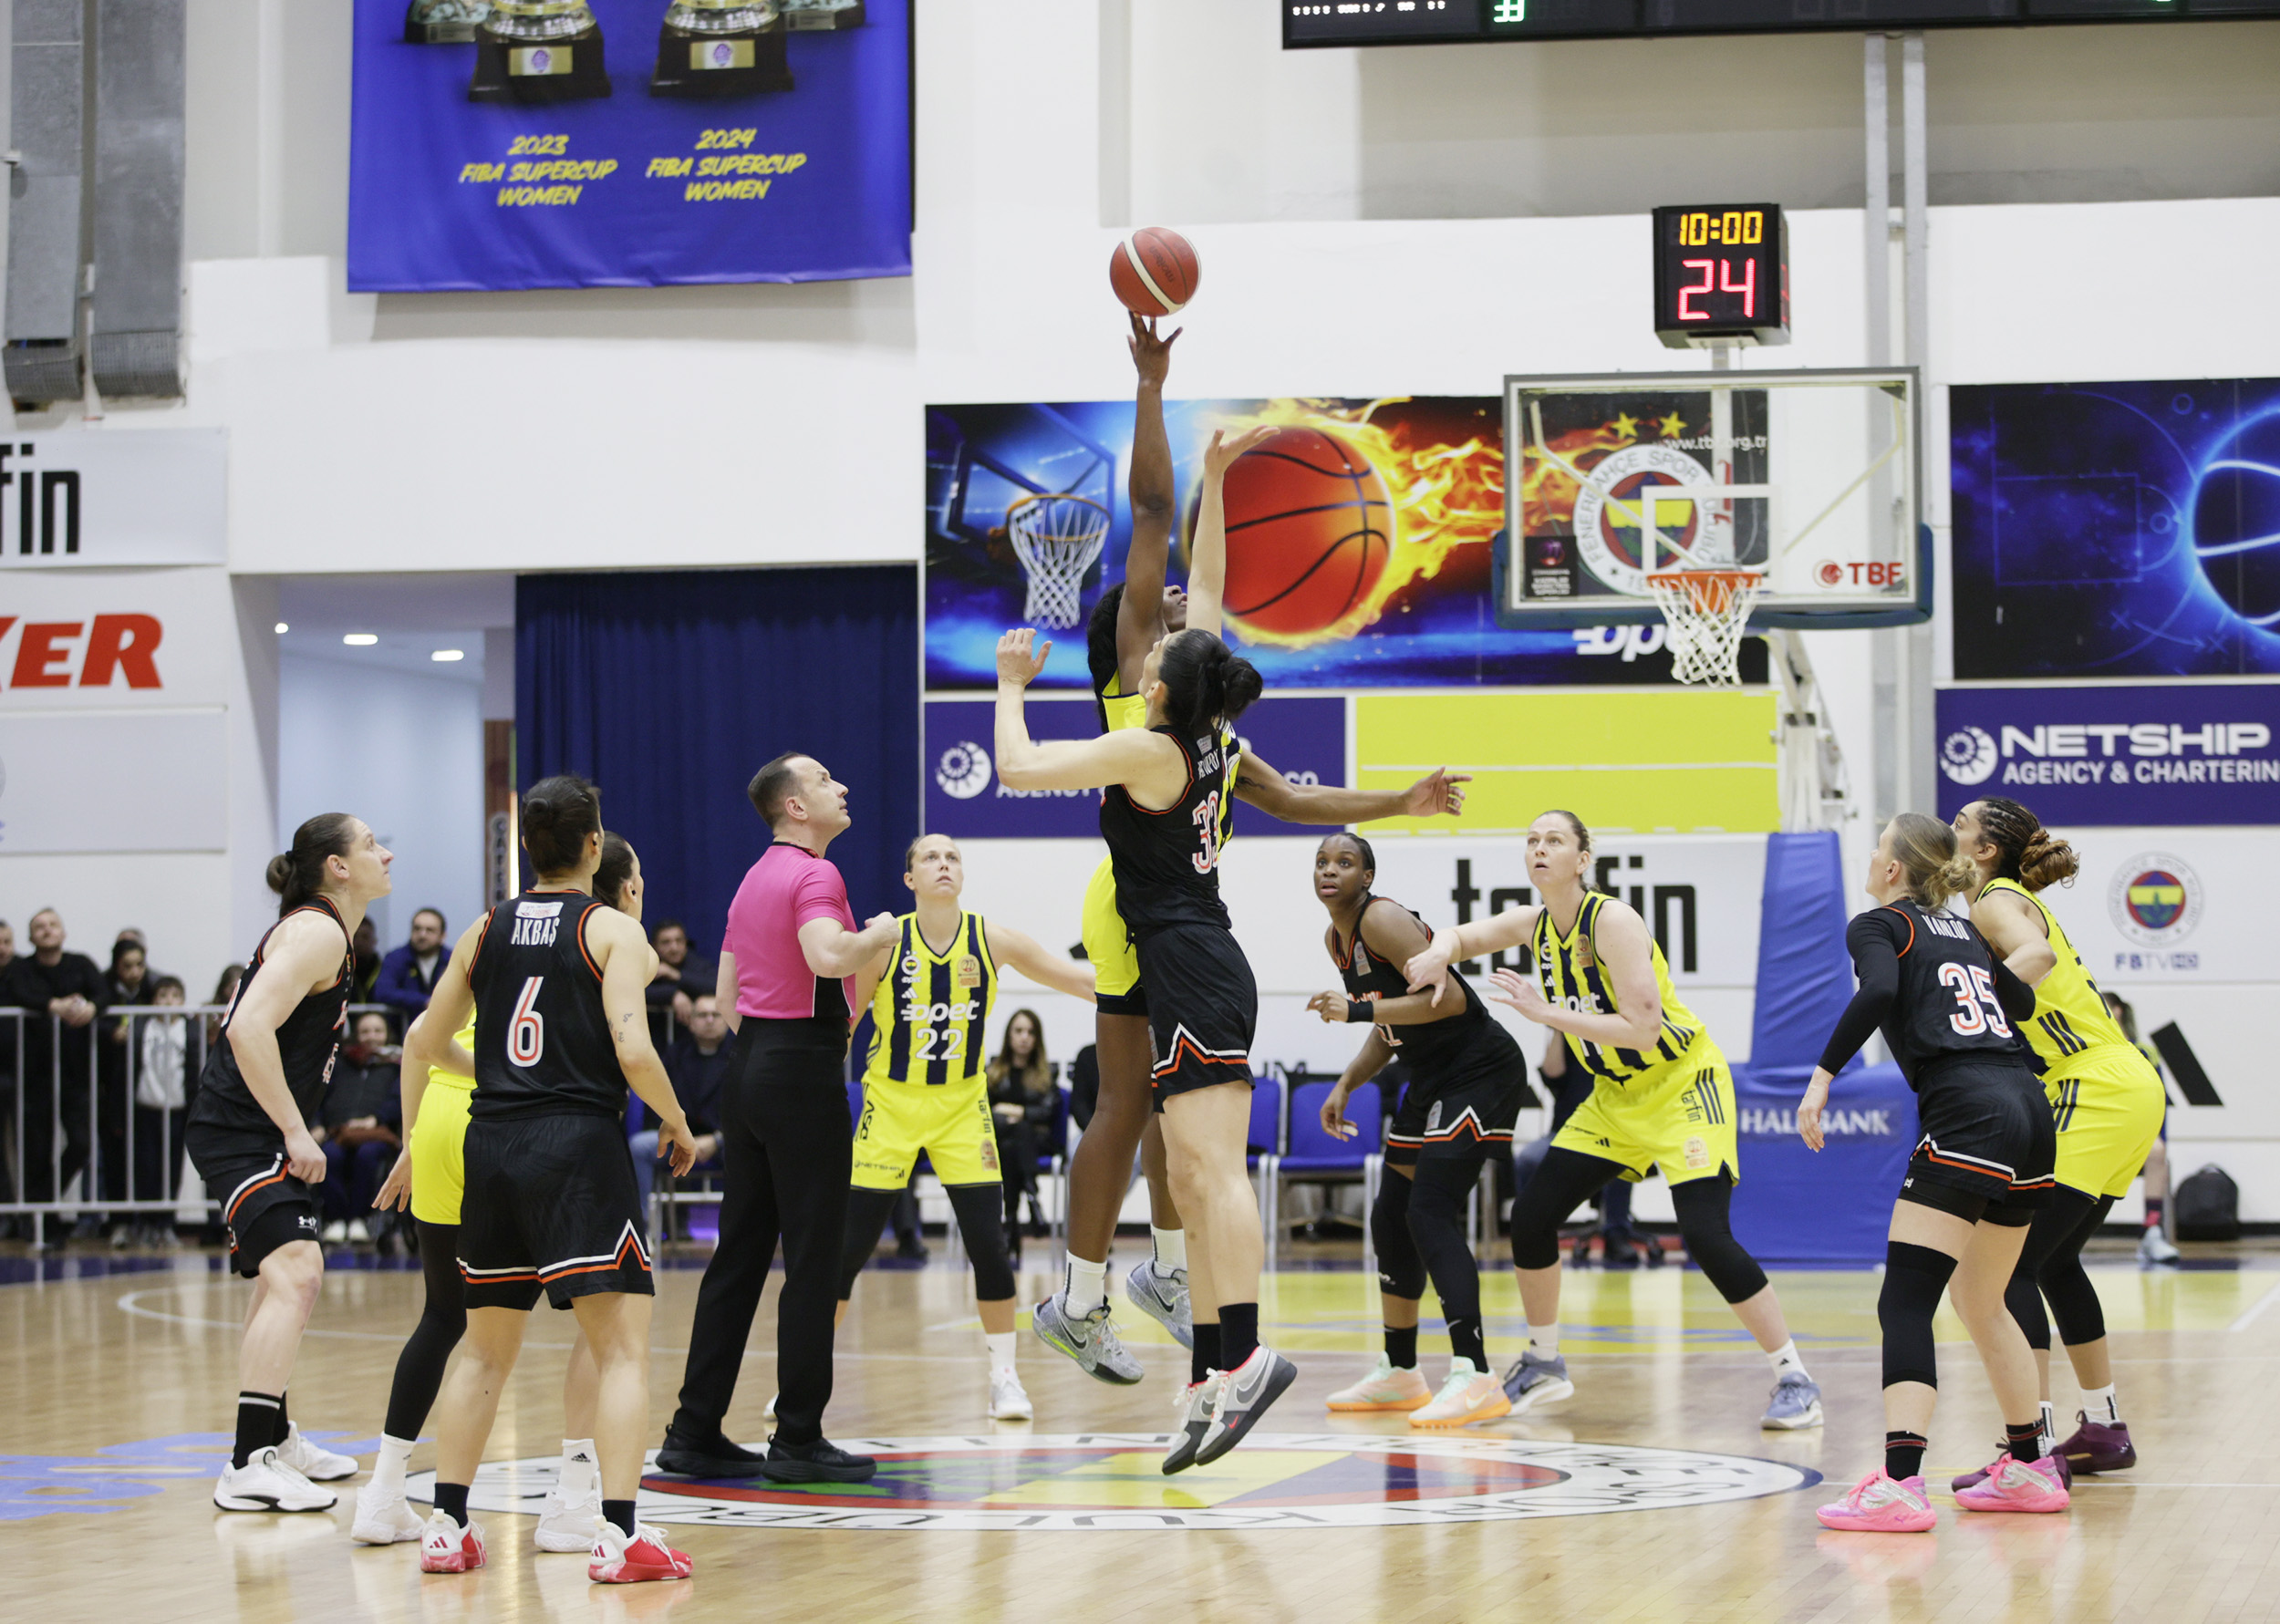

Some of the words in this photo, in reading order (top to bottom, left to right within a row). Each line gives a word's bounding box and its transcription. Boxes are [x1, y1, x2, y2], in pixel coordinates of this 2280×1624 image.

[507, 134, 569, 155] 2023
[695, 128, 757, 150] 2024
[459, 162, 505, 183] FIBA
[507, 159, 618, 181] SUPERCUP
[646, 157, 694, 178] FIBA
[696, 152, 807, 176] SUPERCUP
[497, 185, 583, 206] WOMEN
[685, 179, 772, 201] WOMEN
[1679, 211, 1763, 246] 10:00
[1678, 257, 1756, 320] 24
[1847, 562, 1903, 585] TBF
[2001, 723, 2271, 757] NETSHIP
[2002, 760, 2106, 785] AGENCY
[2109, 760, 2130, 784] &
[1922, 915, 1970, 941] VANLOO
[900, 999, 980, 1025] opet
[1937, 962, 2014, 1038] 35
[507, 977, 544, 1067] 6
[916, 1027, 964, 1060] 22
[1682, 1089, 1703, 1122] tarfin
[1740, 1108, 1891, 1135] HALBANK
